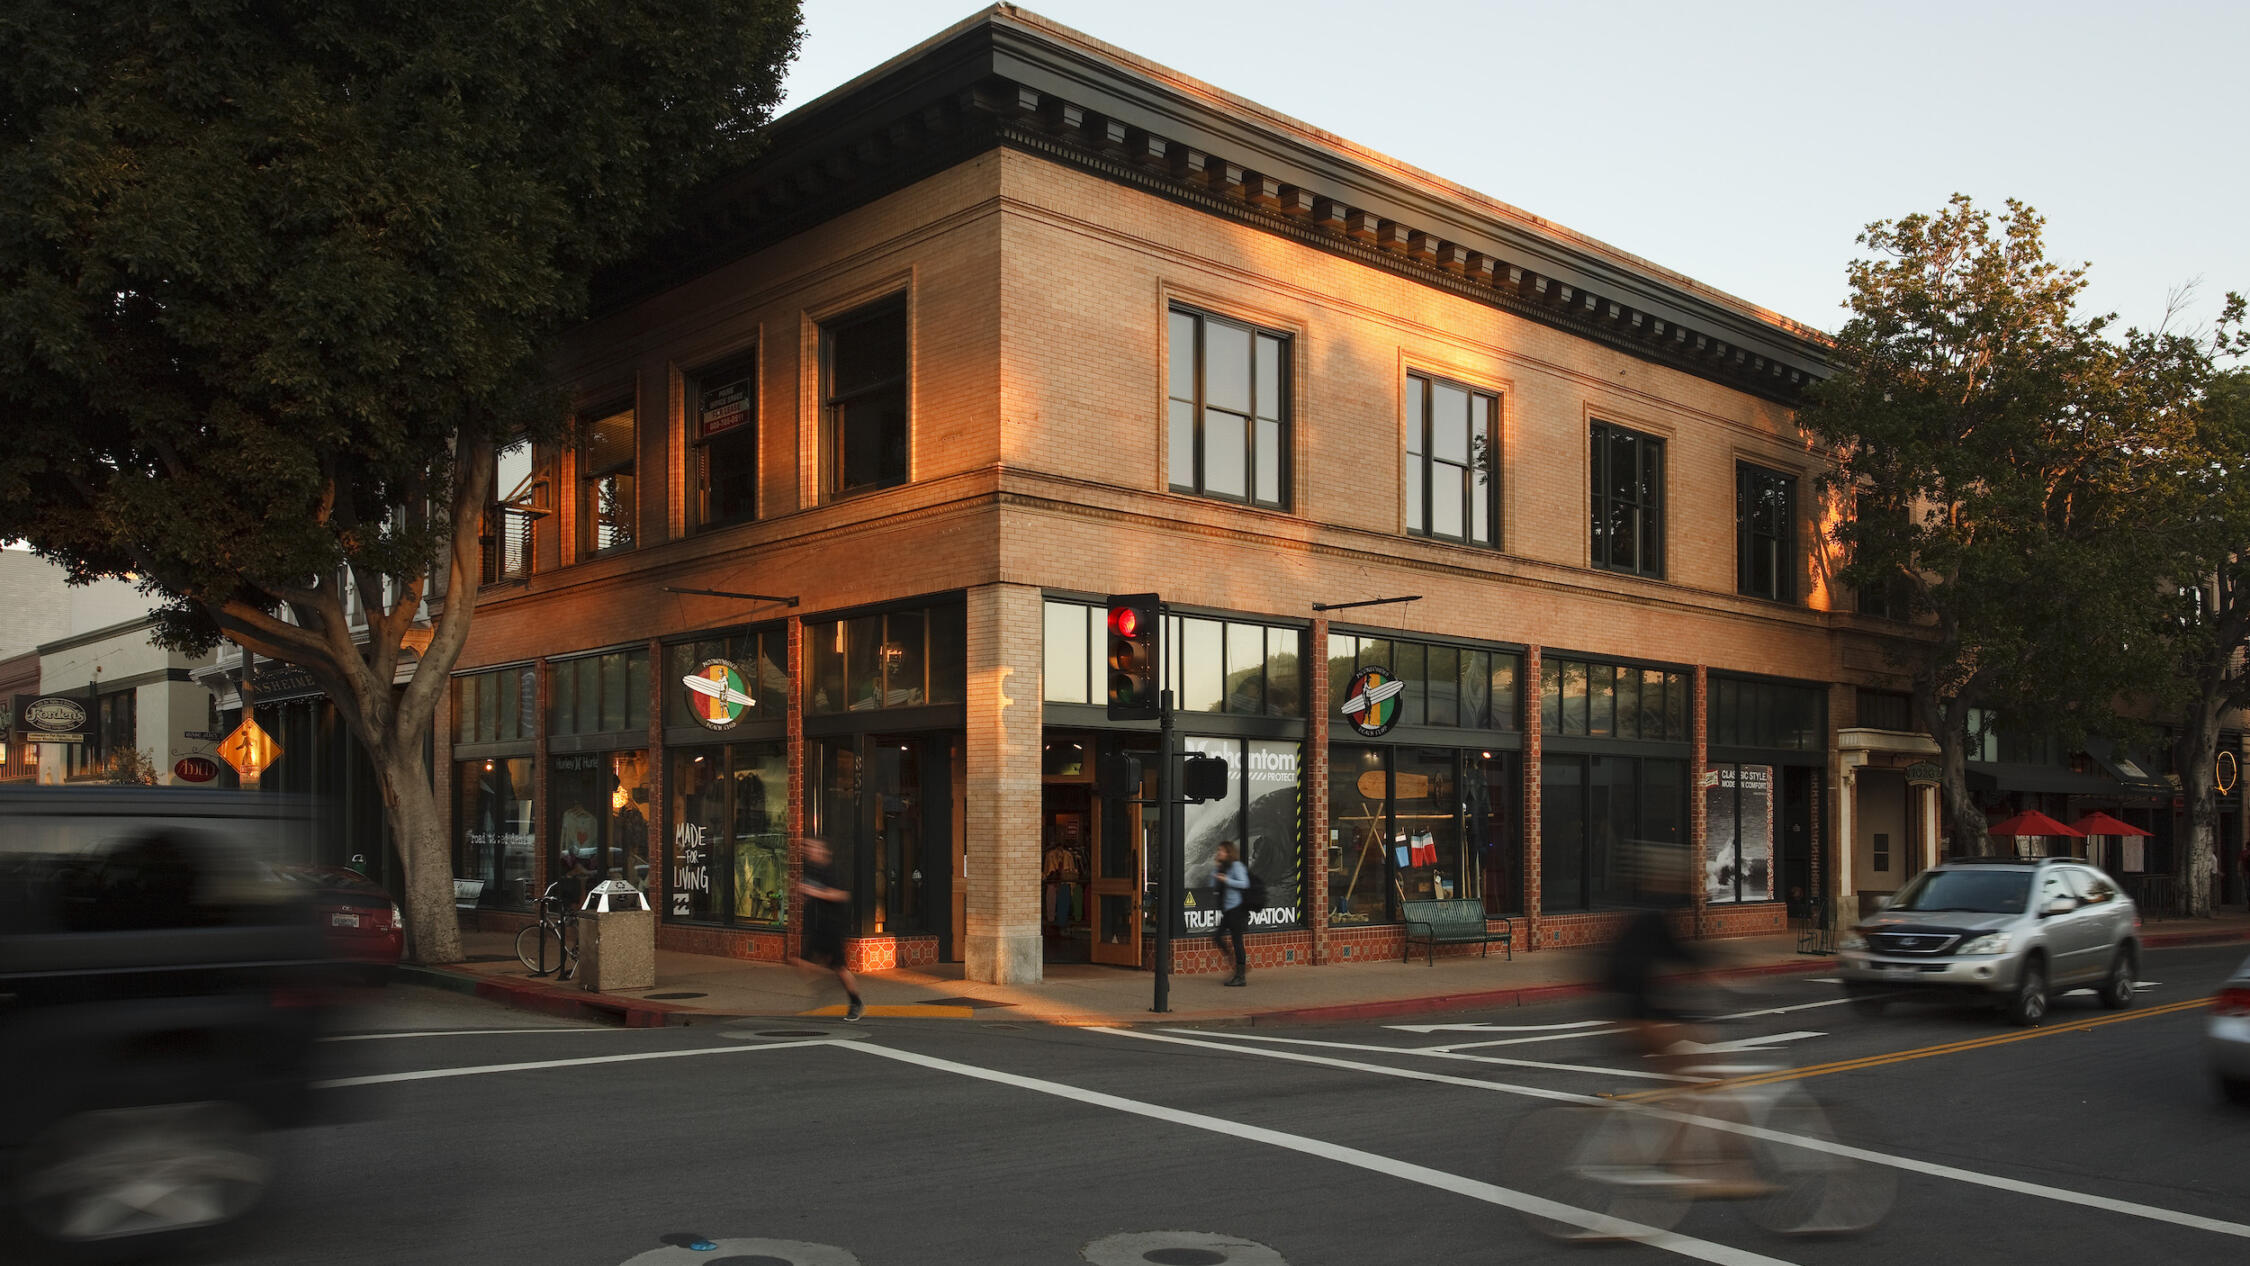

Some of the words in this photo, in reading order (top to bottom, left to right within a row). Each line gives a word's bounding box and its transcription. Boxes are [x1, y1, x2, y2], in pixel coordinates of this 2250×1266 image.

[1267, 771, 1296, 783] PROTECT
[1721, 779, 1744, 789] MODEN
[675, 822, 708, 848] MADE
[673, 865, 709, 895] LIVING
[1184, 910, 1214, 929] TRUE
